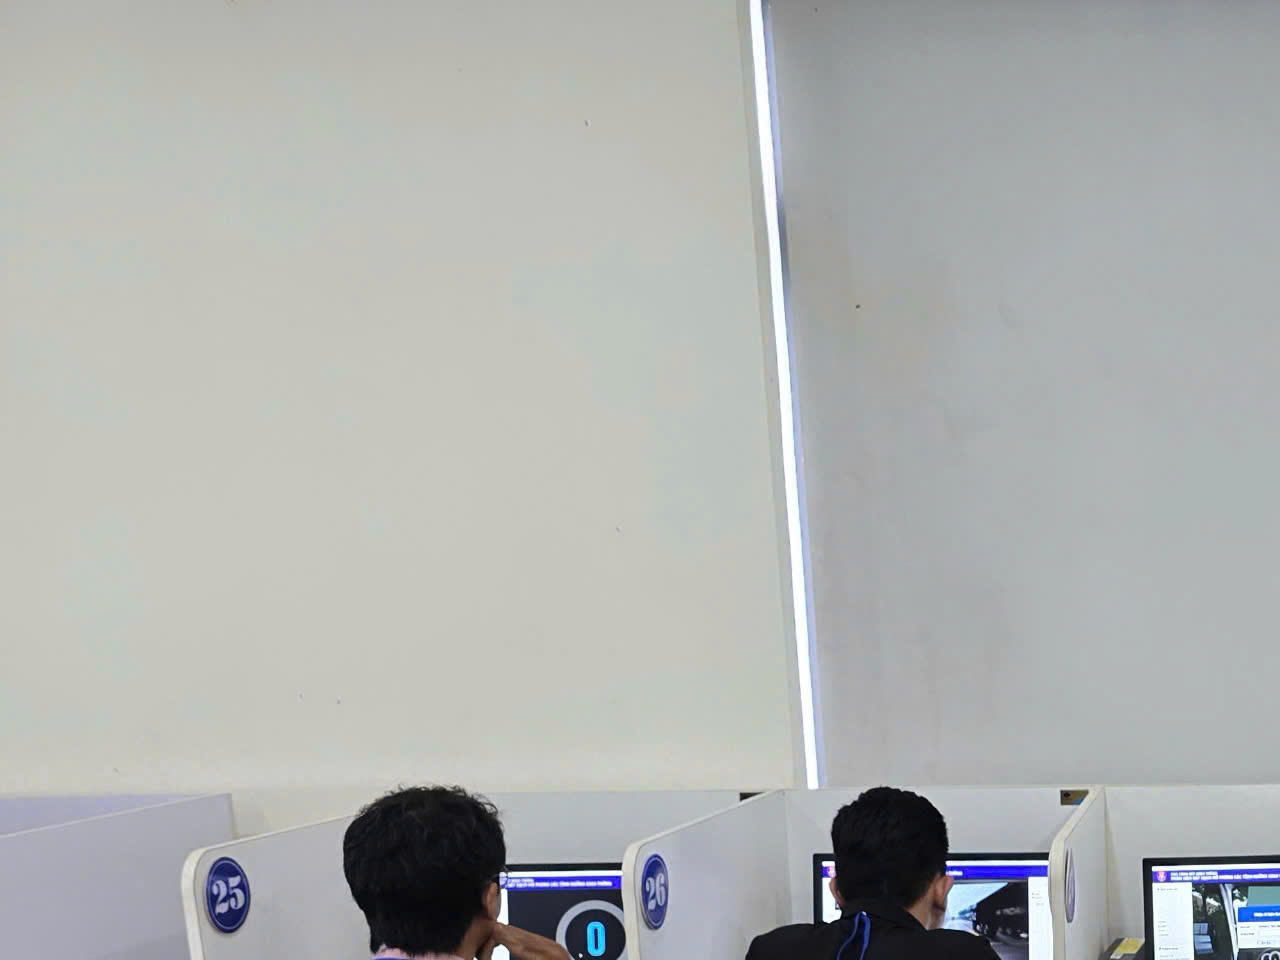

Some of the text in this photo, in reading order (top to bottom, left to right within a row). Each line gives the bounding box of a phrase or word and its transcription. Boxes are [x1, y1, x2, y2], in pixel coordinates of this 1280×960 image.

[211, 875, 246, 916] 25
[645, 872, 666, 911] 26
[586, 921, 606, 957] 0
